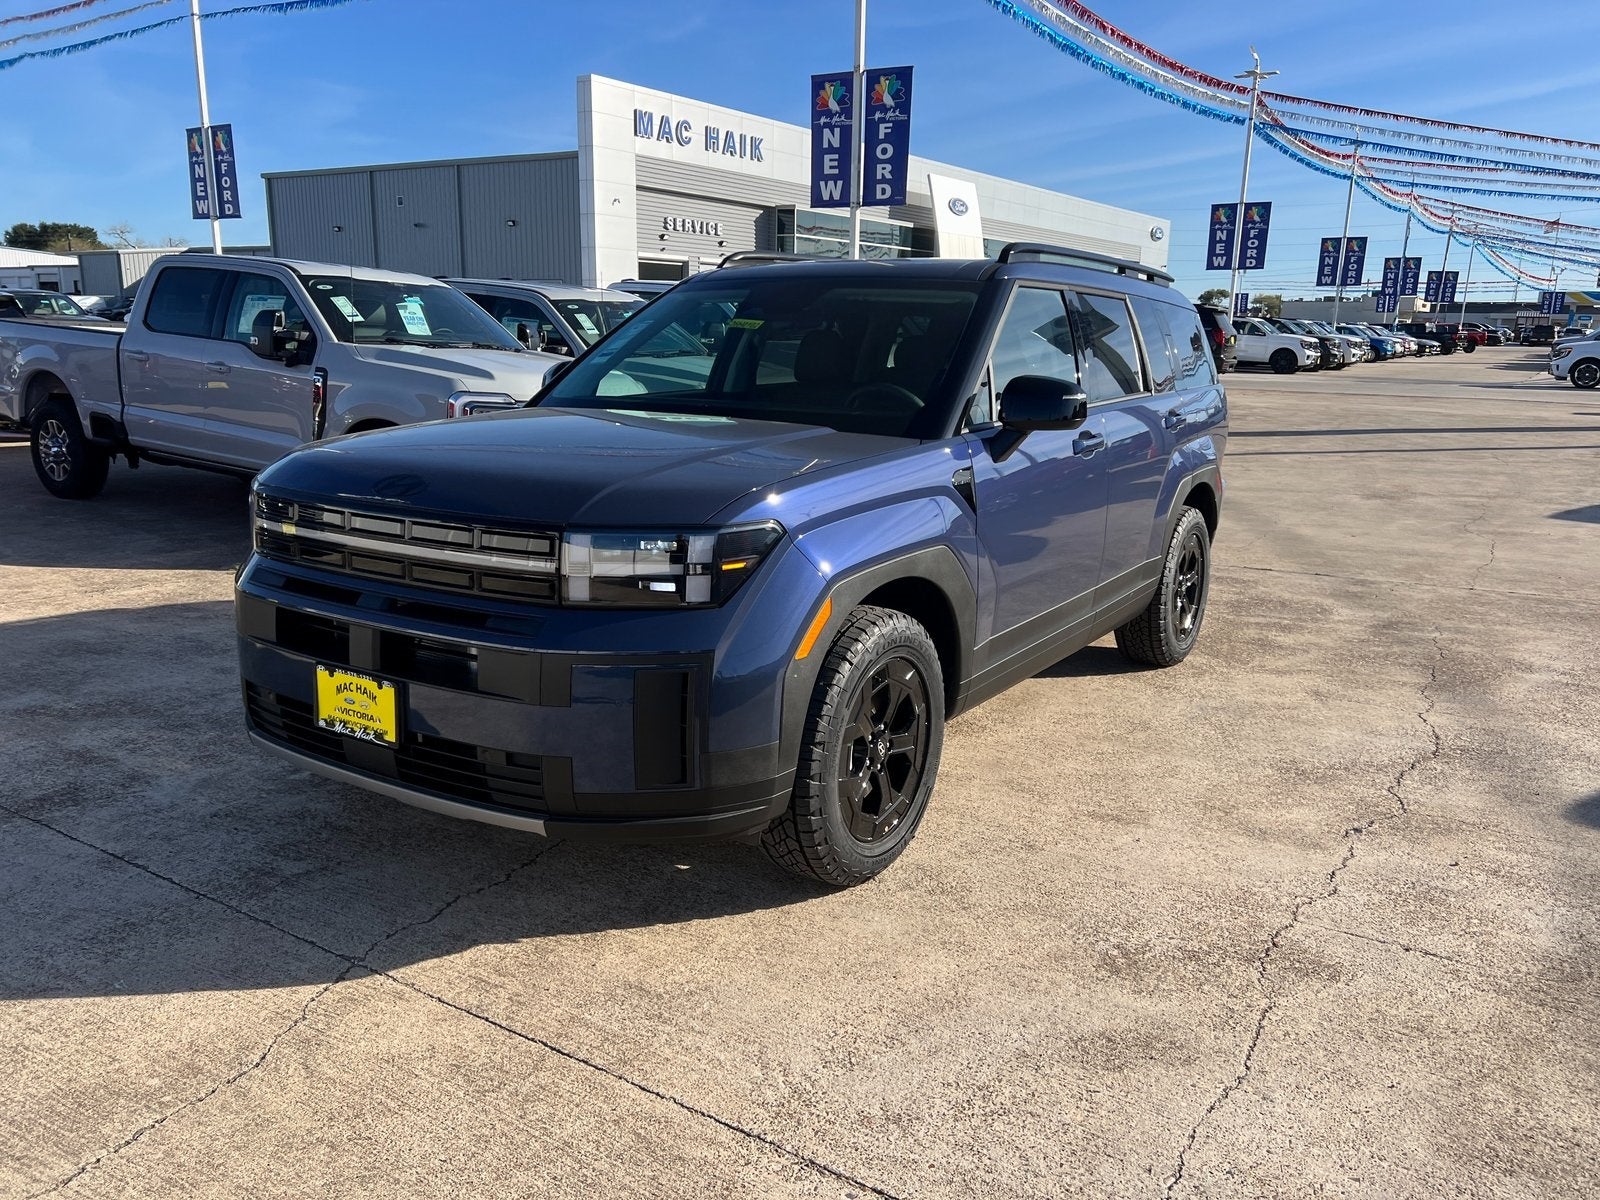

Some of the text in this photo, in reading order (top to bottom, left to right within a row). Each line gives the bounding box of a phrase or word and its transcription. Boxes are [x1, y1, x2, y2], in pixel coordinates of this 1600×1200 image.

[634, 108, 764, 162] MAC HAIK
[820, 127, 844, 201] NEW
[875, 122, 894, 200] FORD
[194, 164, 208, 214] NEW
[220, 163, 234, 215] FORD
[664, 217, 723, 236] SERVICE
[1212, 230, 1227, 267] NEW
[1245, 229, 1259, 267] FORD
[1321, 256, 1334, 284] NEW
[1346, 256, 1358, 285] FORD
[1384, 272, 1395, 294] NEW
[1405, 272, 1415, 294] FORD
[1427, 284, 1437, 301] NEW
[1444, 284, 1453, 301] FORD
[336, 682, 354, 696] MAC
[355, 683, 378, 705] HAIK
[338, 706, 376, 723] VICTORIA
[329, 721, 381, 743] Mac Haik
